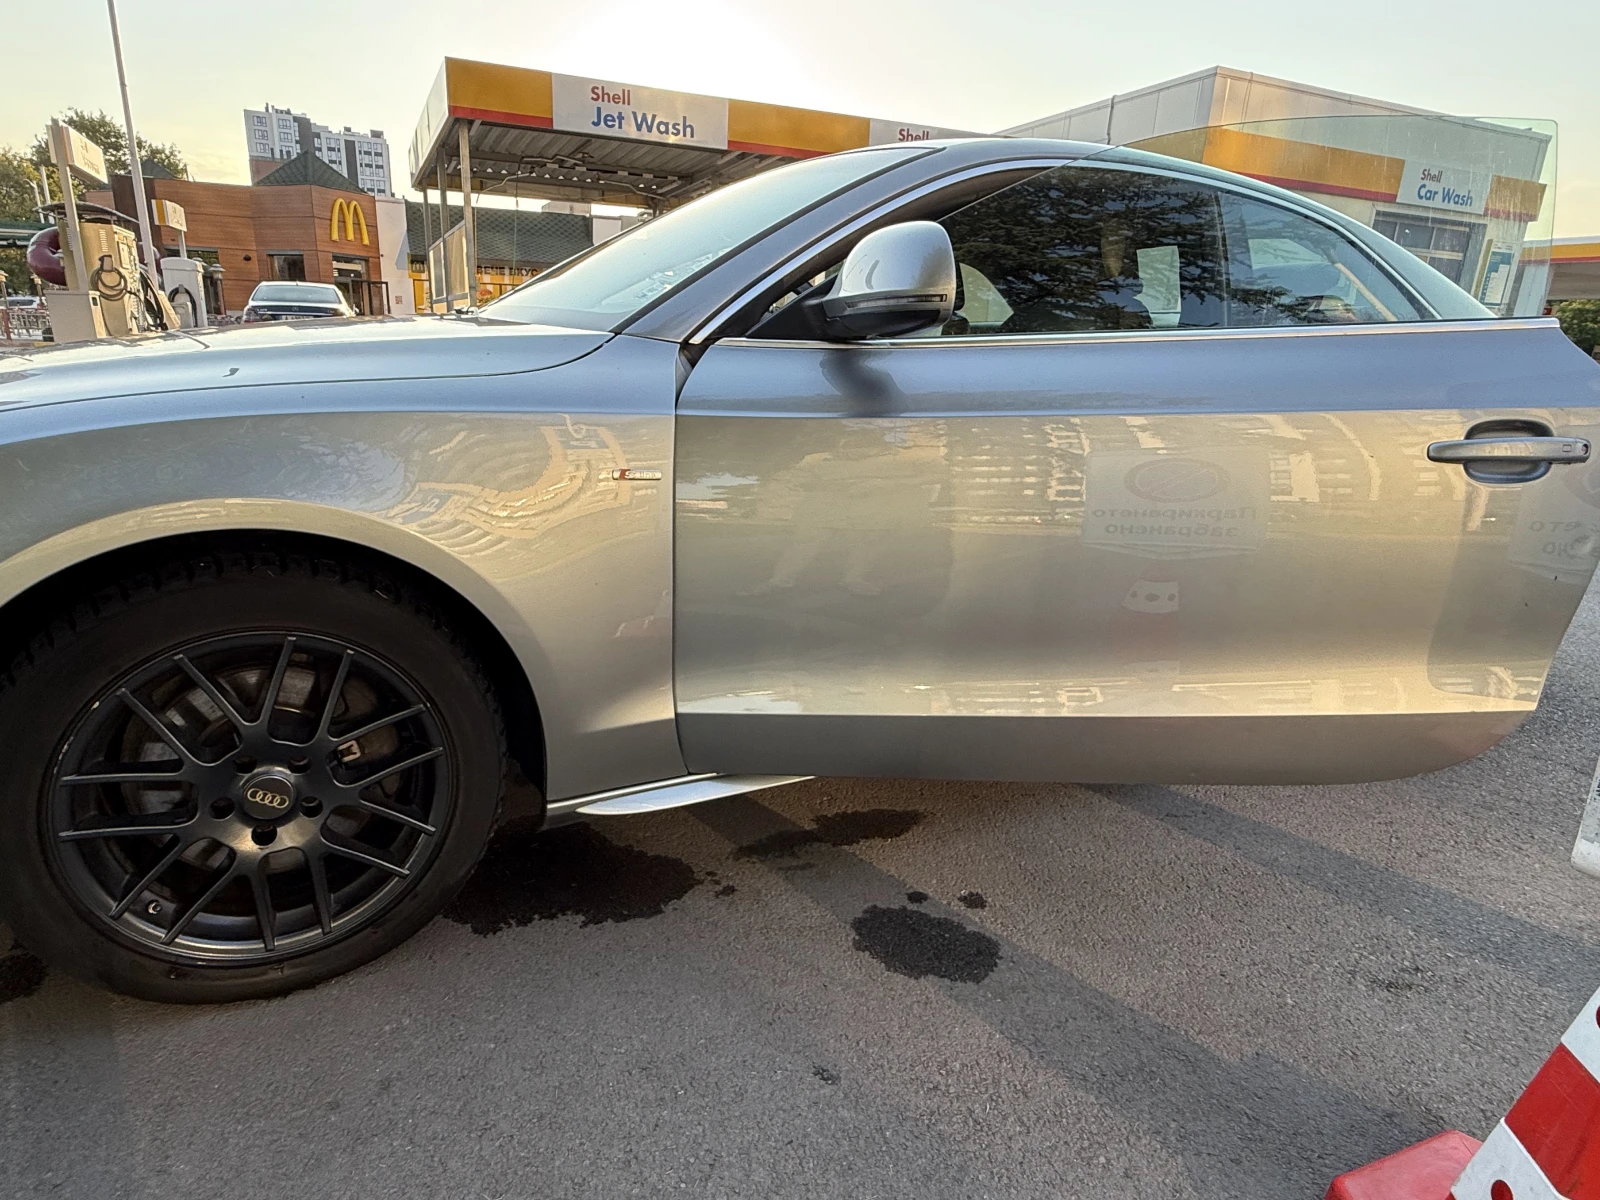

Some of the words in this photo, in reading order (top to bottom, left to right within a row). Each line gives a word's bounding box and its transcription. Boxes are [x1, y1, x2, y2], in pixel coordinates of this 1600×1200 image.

[591, 86, 631, 106] Shell
[591, 106, 625, 129] Jet
[632, 111, 695, 138] Wash
[898, 128, 929, 141] Shell
[1420, 168, 1443, 183] Shell
[1417, 183, 1438, 201] Car
[1441, 187, 1473, 207] Wash
